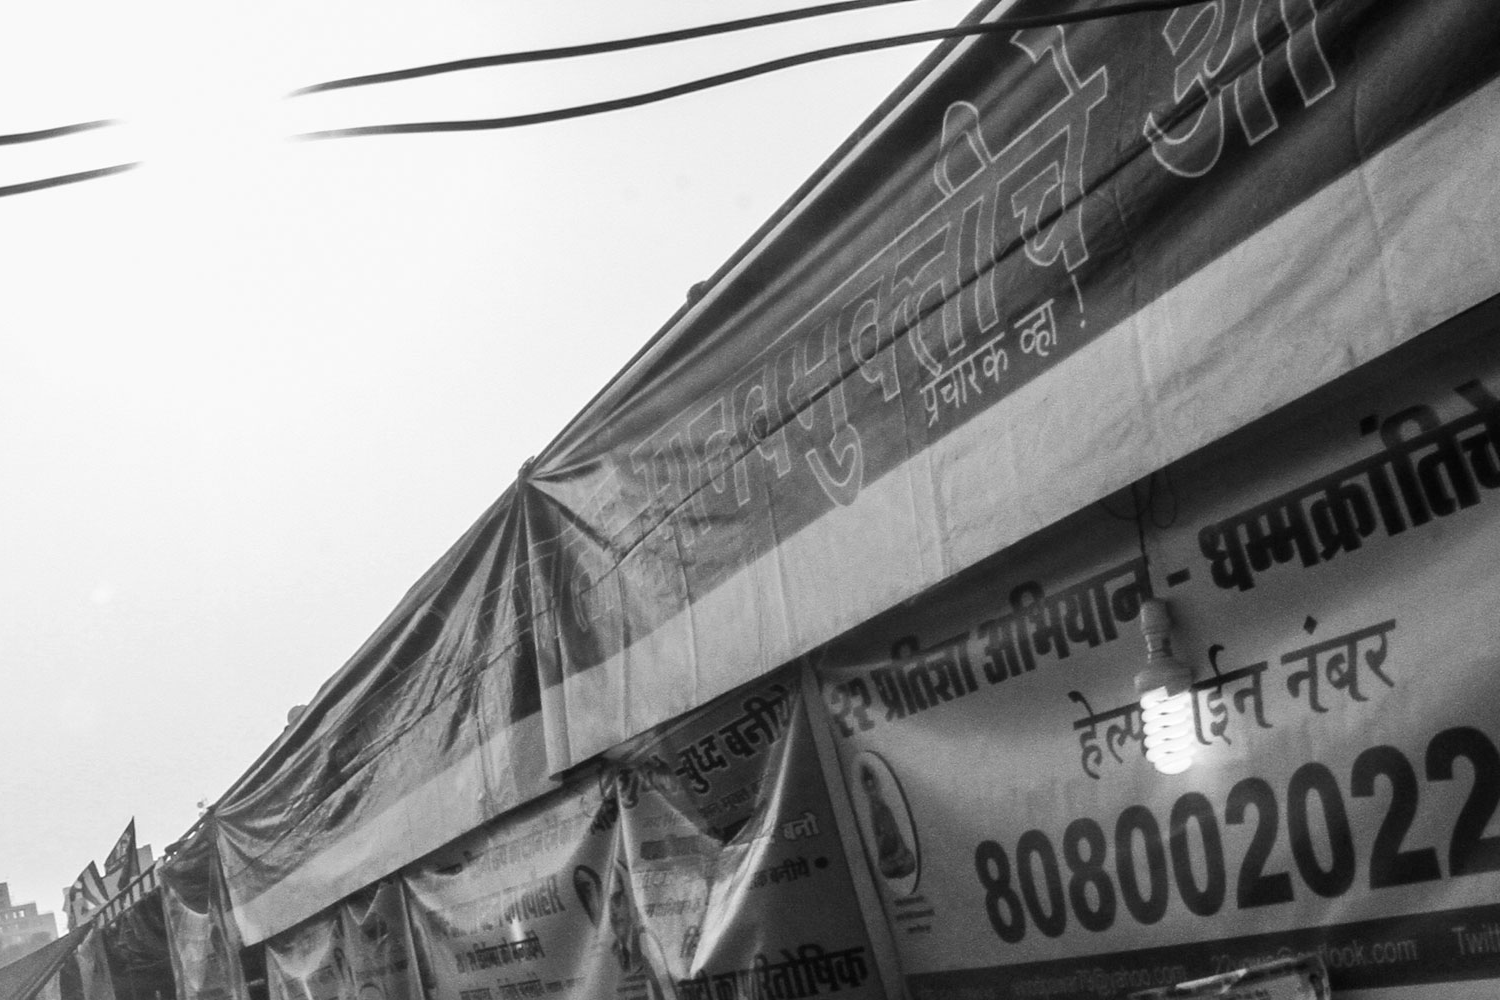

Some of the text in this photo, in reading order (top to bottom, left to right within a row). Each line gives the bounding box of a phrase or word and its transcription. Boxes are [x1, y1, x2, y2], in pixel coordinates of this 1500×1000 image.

[919, 332, 1009, 429] प्रचारक
[1013, 298, 1058, 357] व्हा
[975, 579, 1153, 686] अभियान
[1066, 613, 1397, 781] हेल्पाईन नंबर
[974, 725, 1500, 944] 808002022
